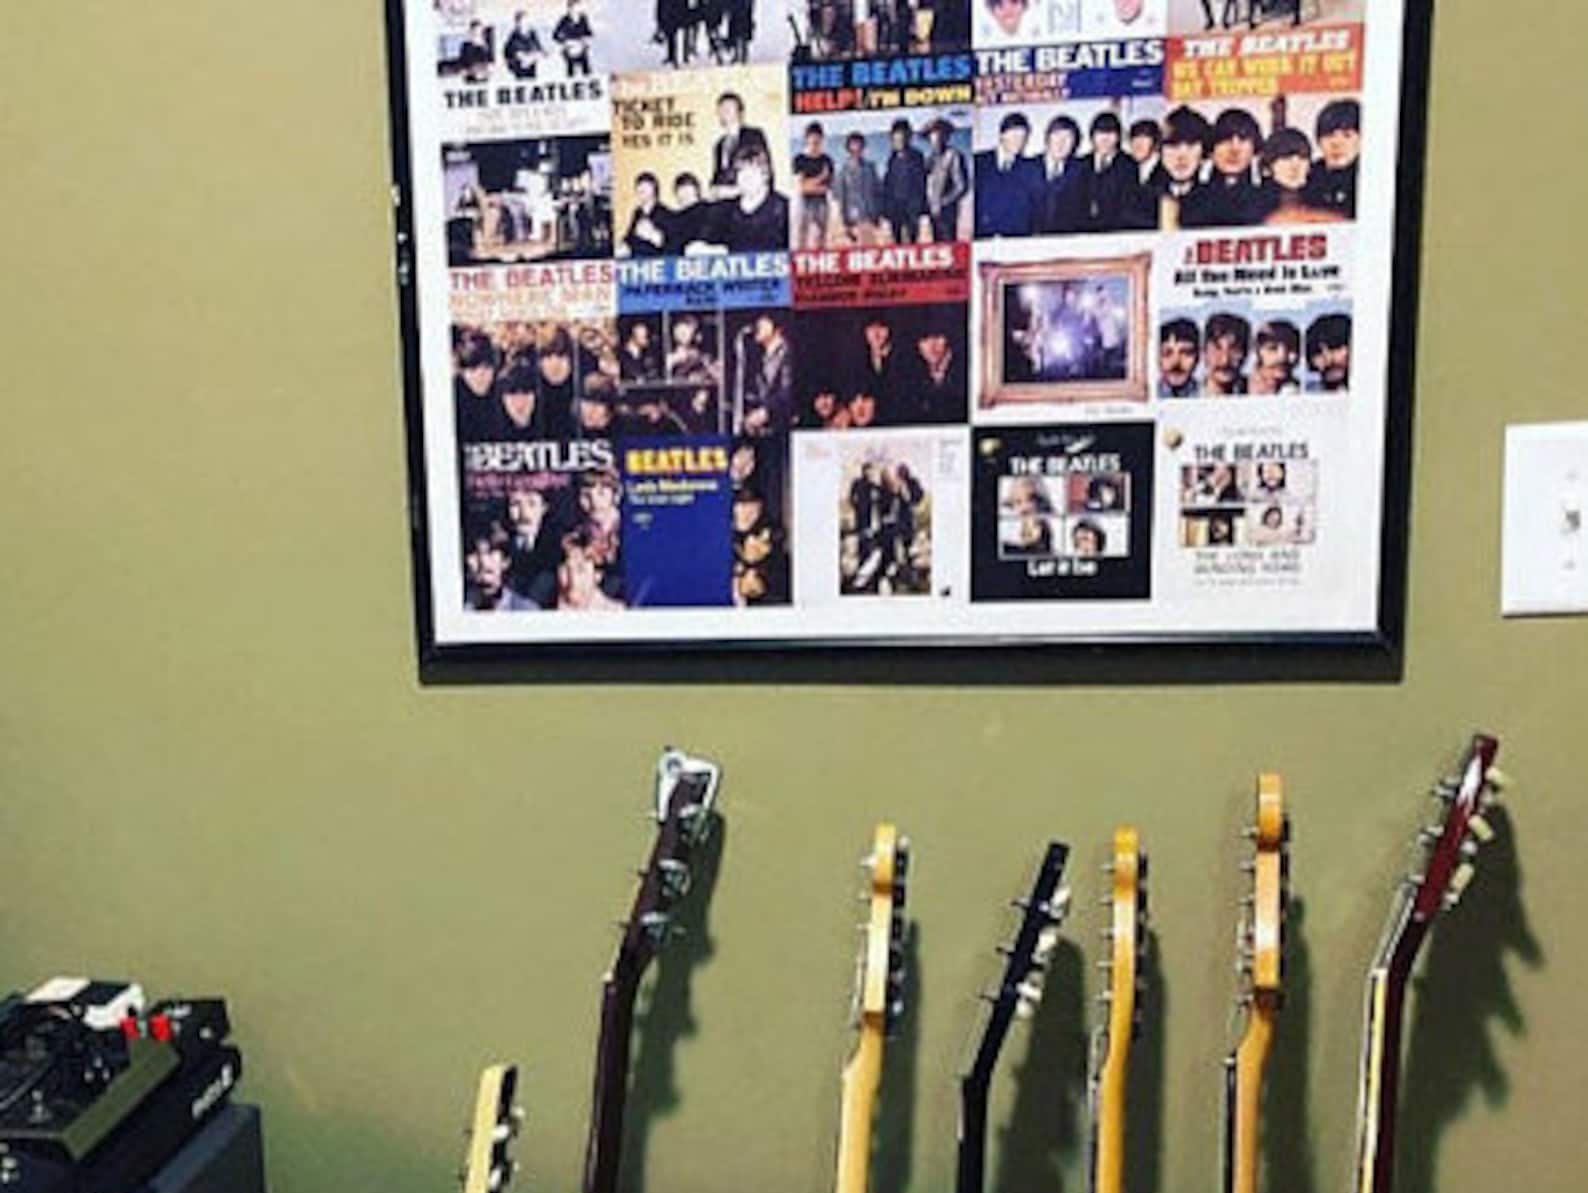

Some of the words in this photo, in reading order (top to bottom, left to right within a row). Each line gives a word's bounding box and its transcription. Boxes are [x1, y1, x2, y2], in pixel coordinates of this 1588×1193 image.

[975, 48, 1032, 73] THE
[1035, 40, 1164, 70] BEATLES
[1183, 38, 1234, 57] THE
[1239, 29, 1350, 56] BEATLES
[794, 64, 845, 88] THE
[852, 55, 972, 86] BEATLES
[444, 90, 488, 108] THE
[496, 80, 604, 104] BEATLES
[612, 97, 675, 114] TICKET
[794, 88, 863, 113] HELP!
[904, 85, 972, 105] DOWN
[653, 113, 696, 127] RIDE
[658, 134, 672, 146] IT
[679, 133, 695, 145] IS
[794, 251, 841, 276] THE
[848, 245, 954, 274] BEATLES
[1197, 233, 1328, 264] BEATLES
[451, 270, 493, 291] THE
[506, 264, 613, 288] BEATLES
[617, 259, 665, 284] THE
[676, 252, 789, 281] BEATLES
[474, 439, 614, 472] BEATLES
[626, 446, 729, 475] BEATLES
[1009, 456, 1042, 474] THE
[1046, 453, 1121, 472] BEATLES
[1195, 444, 1226, 460] THE
[1234, 442, 1309, 460] BEATLES
